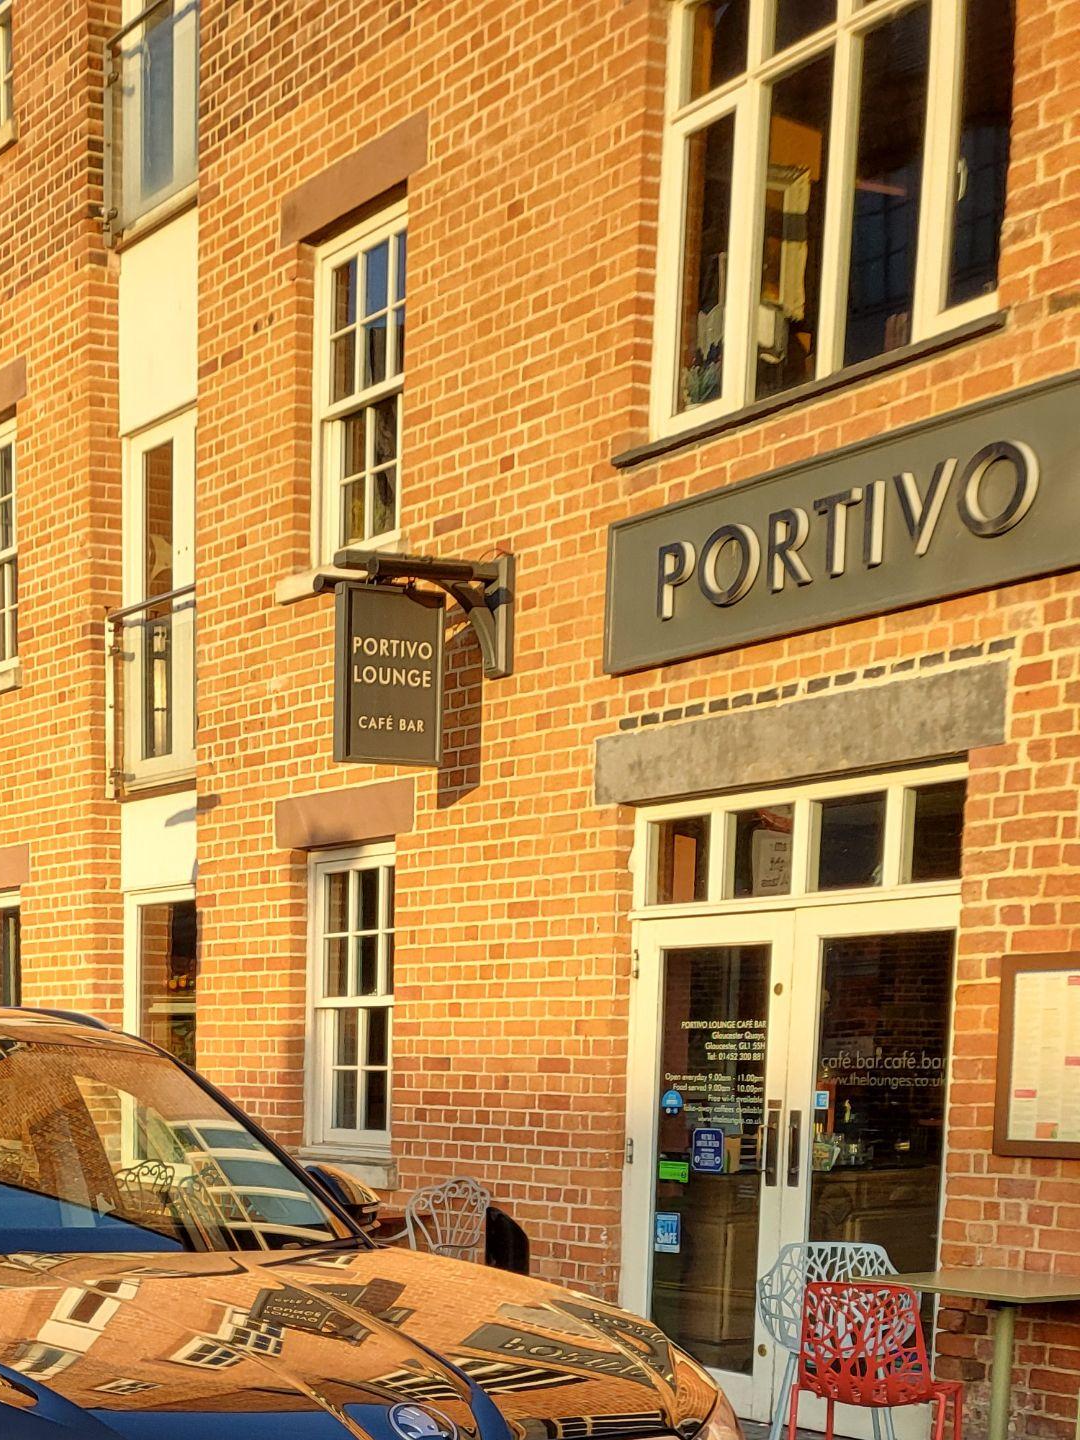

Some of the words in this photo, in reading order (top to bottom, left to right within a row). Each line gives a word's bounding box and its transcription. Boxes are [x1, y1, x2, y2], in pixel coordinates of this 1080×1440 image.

[656, 440, 1040, 622] PORTIVO
[352, 636, 433, 660] PORTIVO
[353, 665, 432, 688] LOUNGE
[358, 715, 393, 731] CAFÉ
[399, 718, 424, 733] BAR
[708, 1020, 736, 1029] LOUNGE
[754, 1020, 767, 1029] BAR
[711, 1031, 744, 1040] Gloucester
[664, 1072, 681, 1082] Open
[656, 1228, 678, 1244] SAFE
